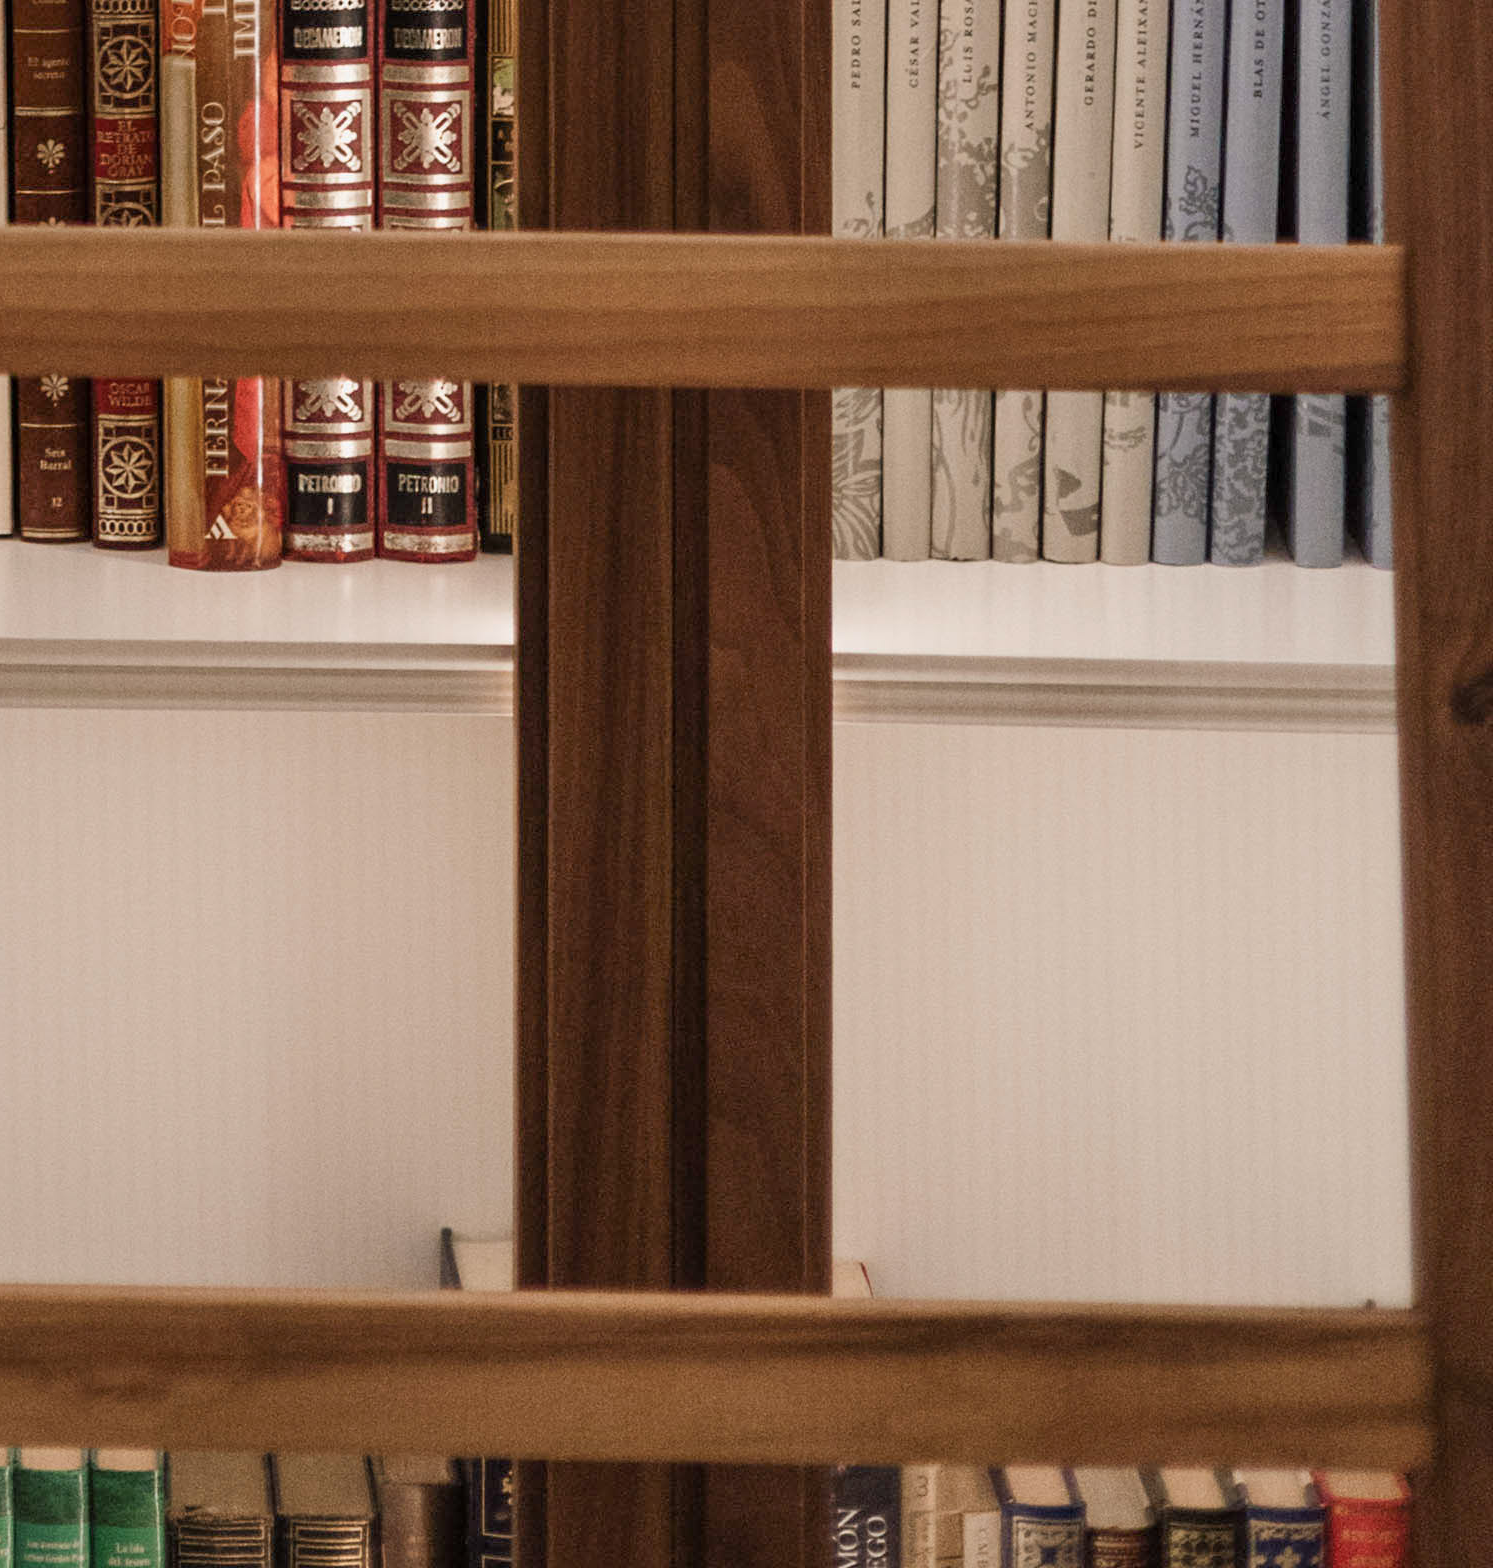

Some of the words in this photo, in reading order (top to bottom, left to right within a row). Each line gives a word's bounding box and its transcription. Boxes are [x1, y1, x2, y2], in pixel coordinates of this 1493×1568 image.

[851, 34, 861, 89] PEDRO
[1025, 51, 1036, 131] ANTONIO
[1084, 27, 1096, 106] GERARDO
[1190, 74, 1202, 138] MIGUEL
[1318, 67, 1330, 120] ÁNGEL
[399, 473, 459, 495] PETRONIO
